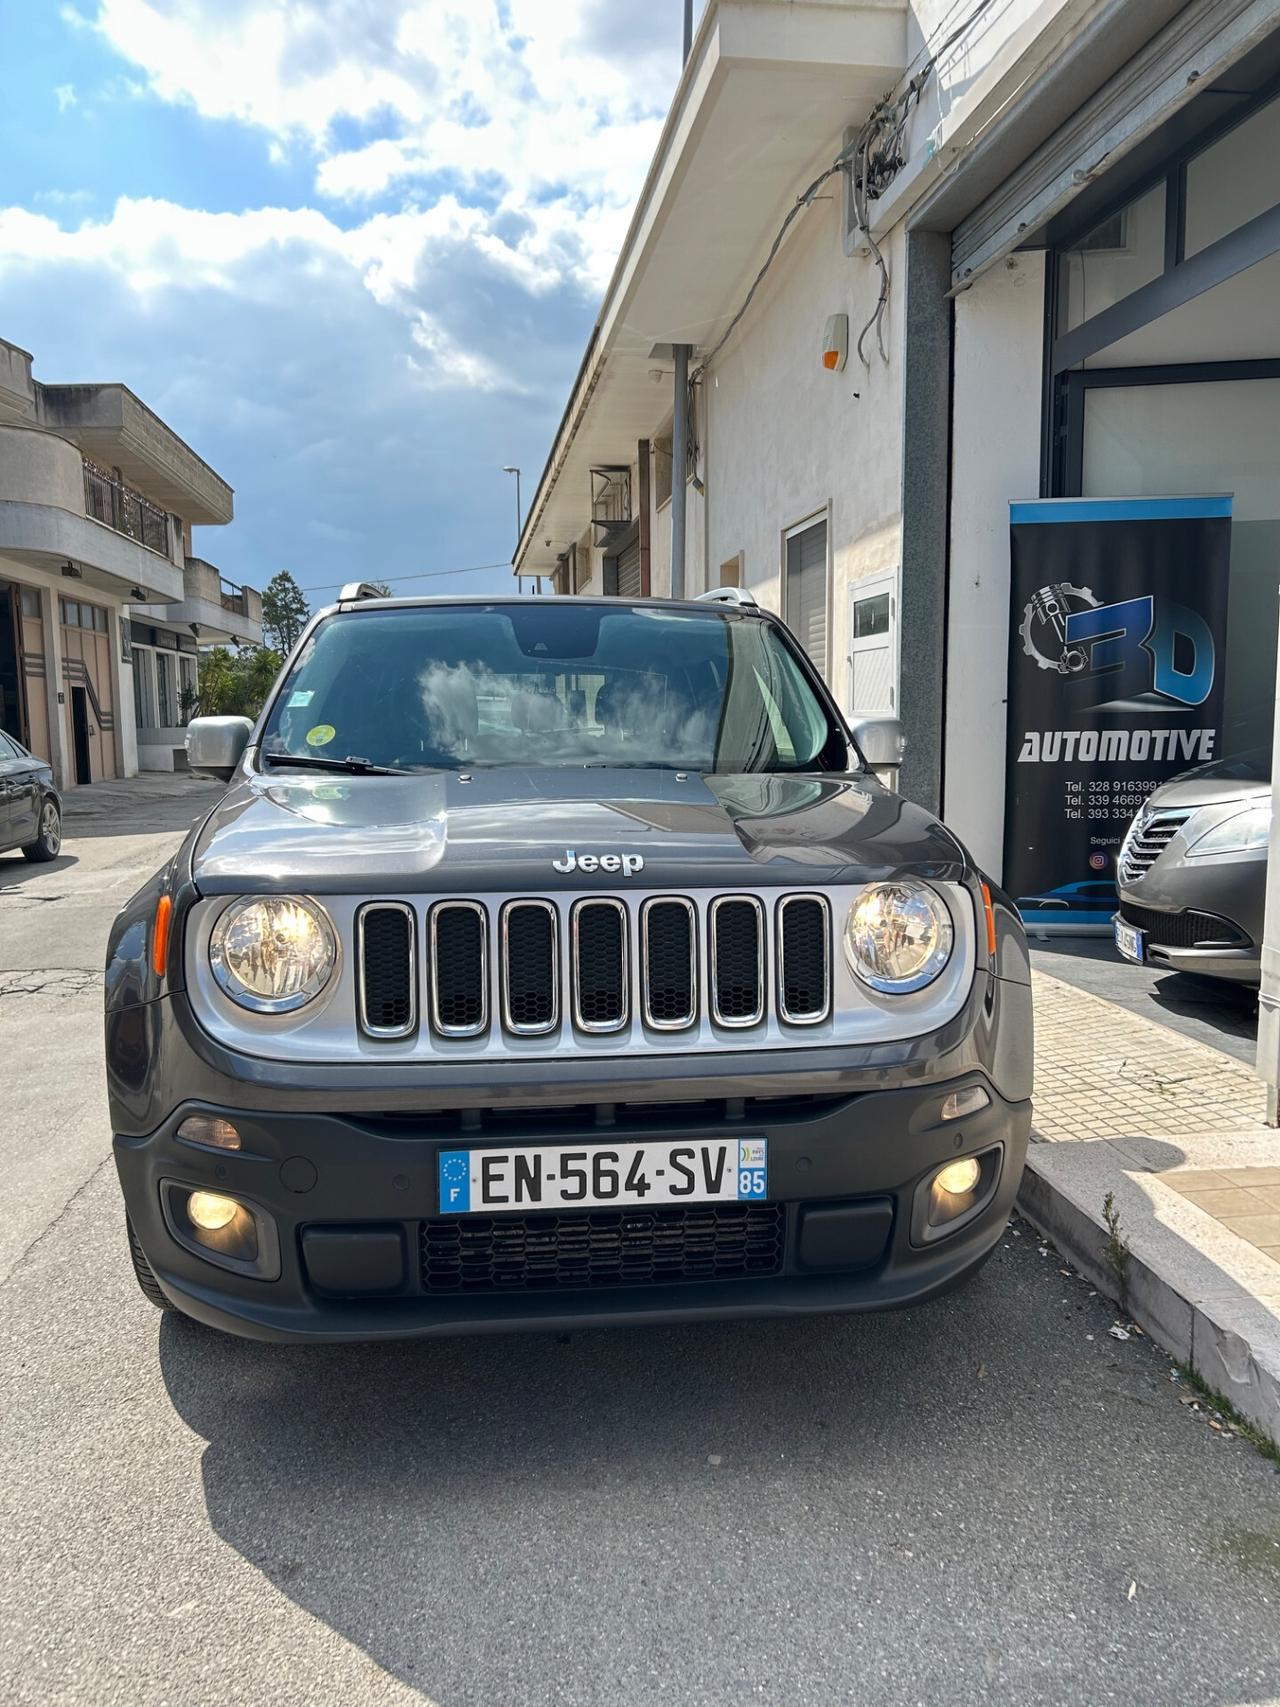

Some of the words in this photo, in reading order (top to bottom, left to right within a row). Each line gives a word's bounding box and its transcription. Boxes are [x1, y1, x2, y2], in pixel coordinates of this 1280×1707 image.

[1017, 729, 1216, 763] AUTOMOTIVE
[1065, 781, 1085, 792] Tel.
[1088, 781, 1110, 792] 328
[1065, 795, 1085, 806] Tel.
[1088, 795, 1110, 806] 339
[1064, 808, 1084, 819] Tel.
[1087, 808, 1109, 819] 393
[1090, 837, 1120, 846] Seguici
[552, 850, 644, 877] Jeep
[450, 1188, 460, 1203] F
[481, 1146, 727, 1204] EN-564-SV
[740, 1171, 765, 1194] 85
